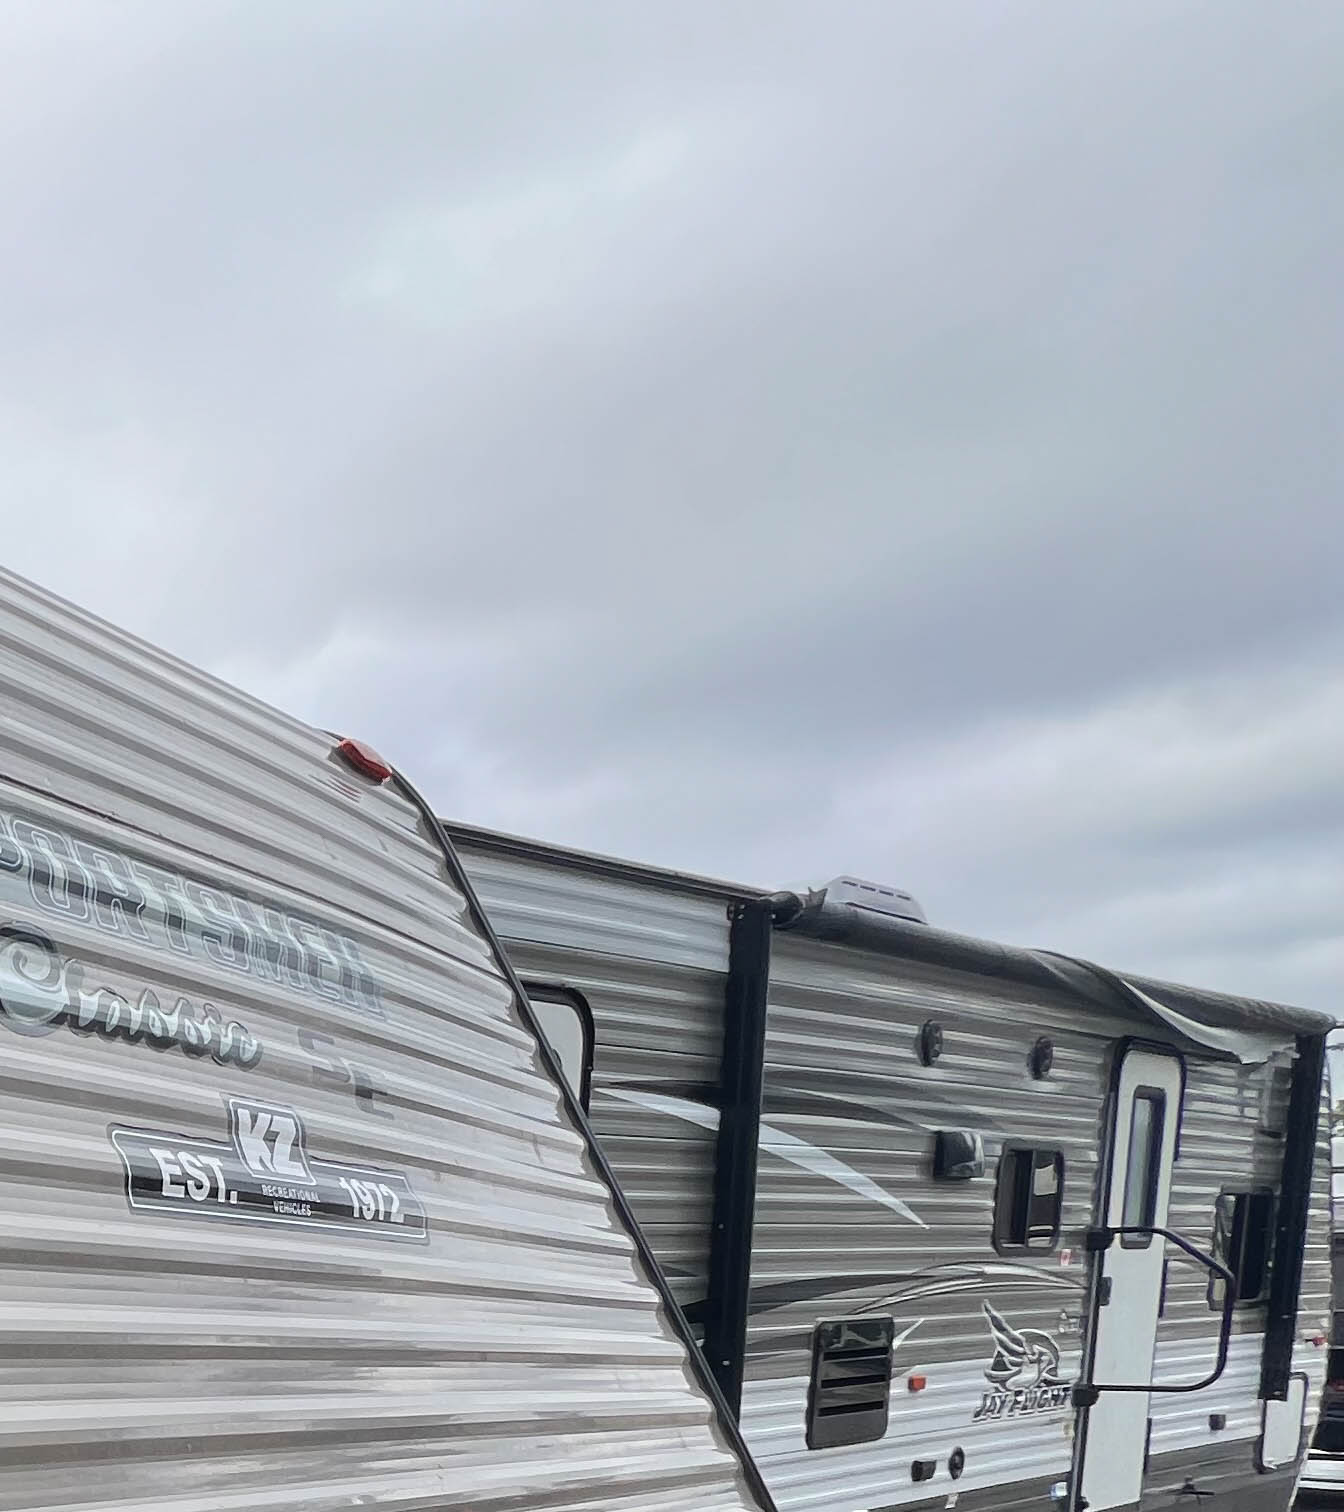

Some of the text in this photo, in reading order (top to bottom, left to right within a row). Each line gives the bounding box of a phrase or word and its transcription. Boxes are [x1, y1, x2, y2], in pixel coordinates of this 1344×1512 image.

[237, 1108, 308, 1178] KZ
[149, 1148, 405, 1224] EST. 1972
[261, 1184, 321, 1203] RECREATIONAL
[273, 1200, 313, 1217] VEHICLES
[973, 1391, 1015, 1420] JAY
